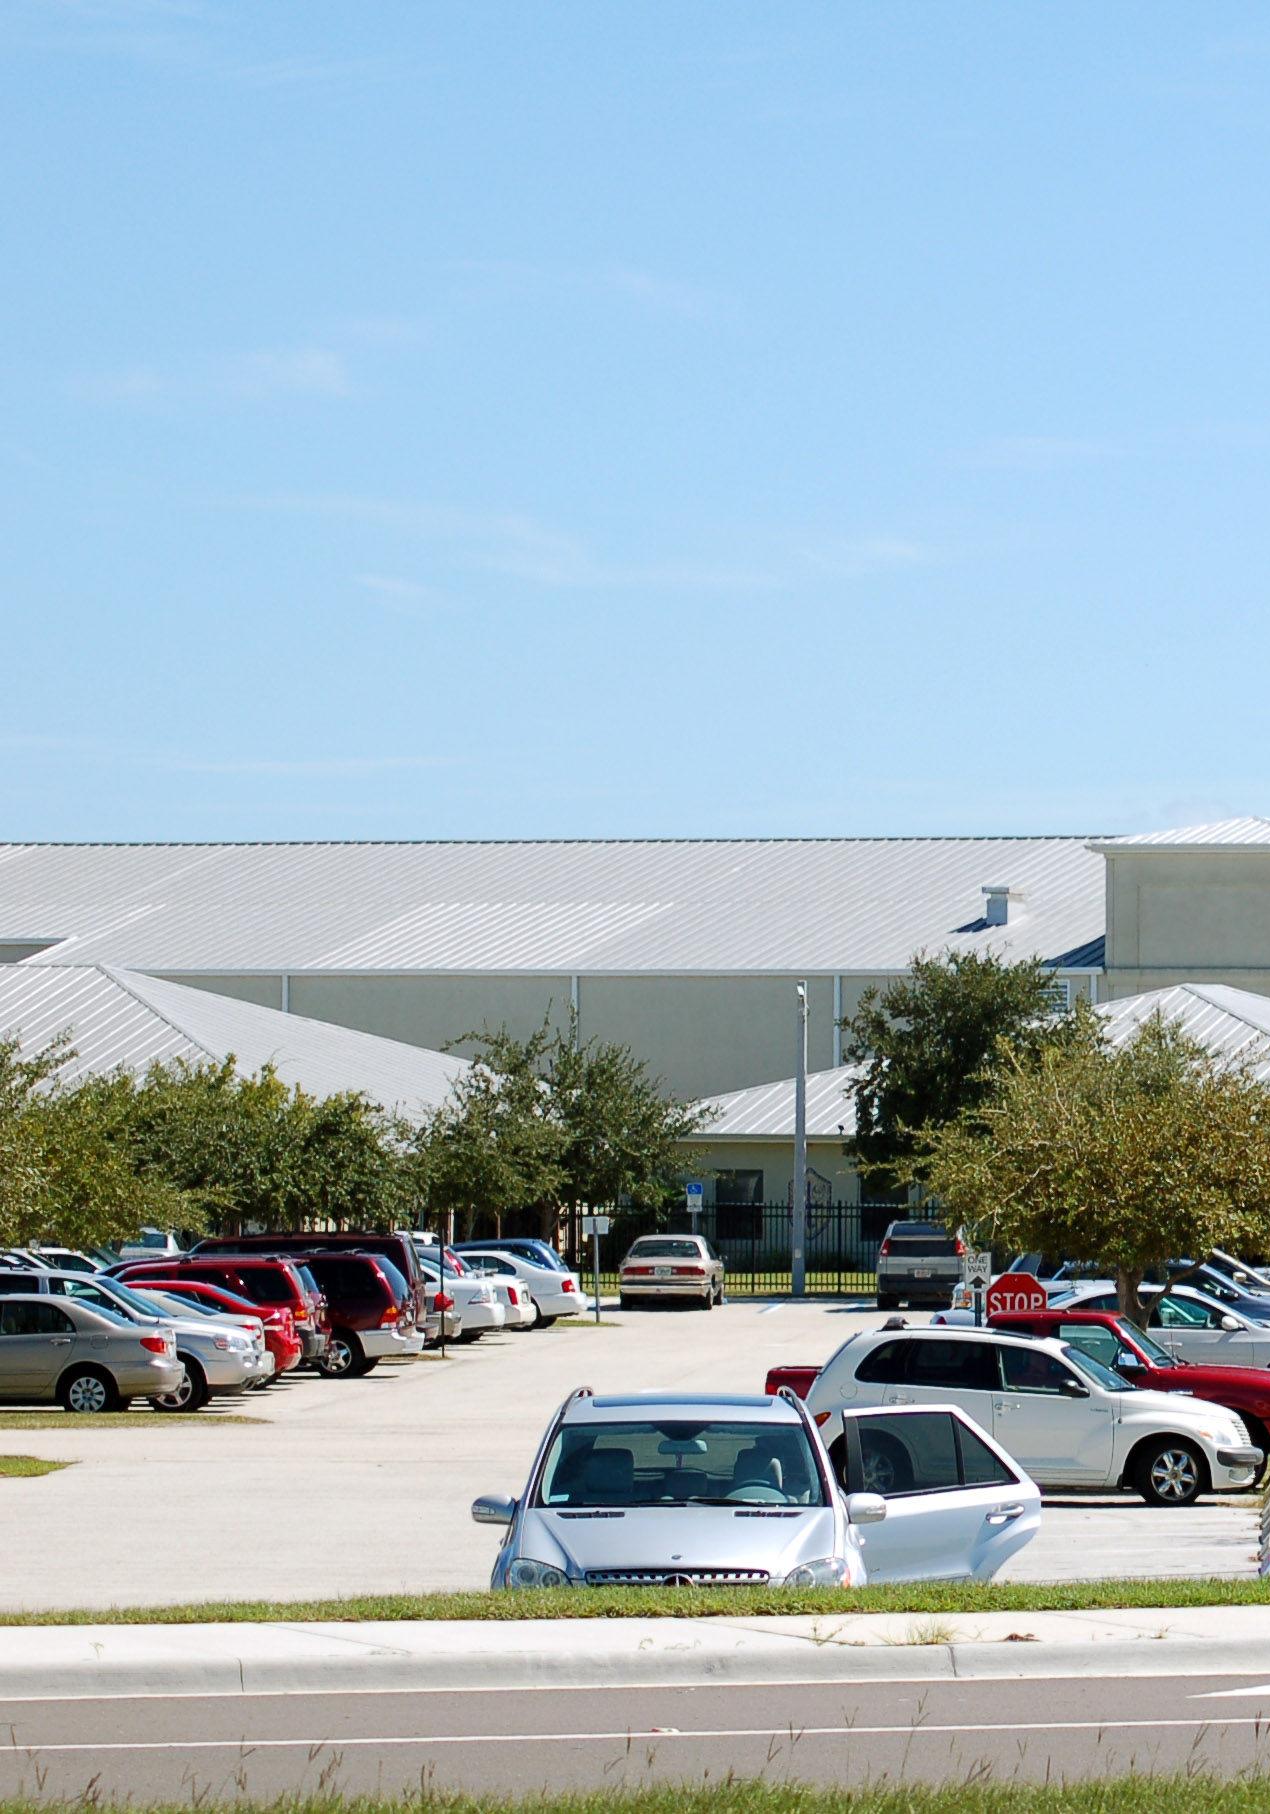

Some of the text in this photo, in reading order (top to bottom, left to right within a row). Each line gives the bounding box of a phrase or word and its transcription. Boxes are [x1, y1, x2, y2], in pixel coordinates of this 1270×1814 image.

[967, 1255, 987, 1264] ONE
[967, 1265, 988, 1273] WAY
[990, 1292, 1043, 1312] STOP
